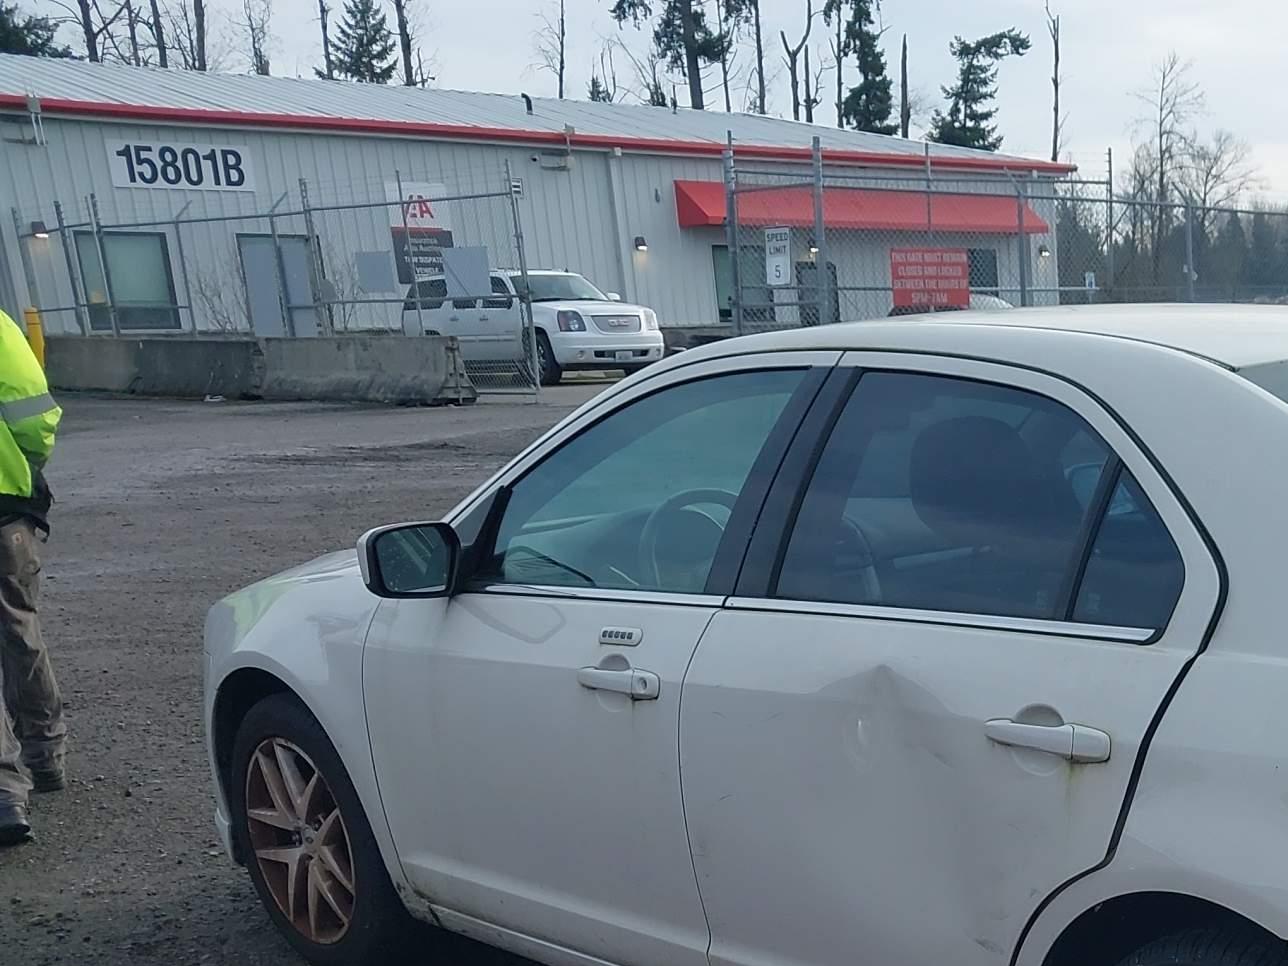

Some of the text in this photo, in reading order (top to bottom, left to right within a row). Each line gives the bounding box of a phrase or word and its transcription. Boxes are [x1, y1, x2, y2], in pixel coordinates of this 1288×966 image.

[116, 144, 245, 187] 15801B
[766, 232, 788, 241] SPEED
[769, 245, 786, 255] LIMIT
[775, 264, 781, 278] 5
